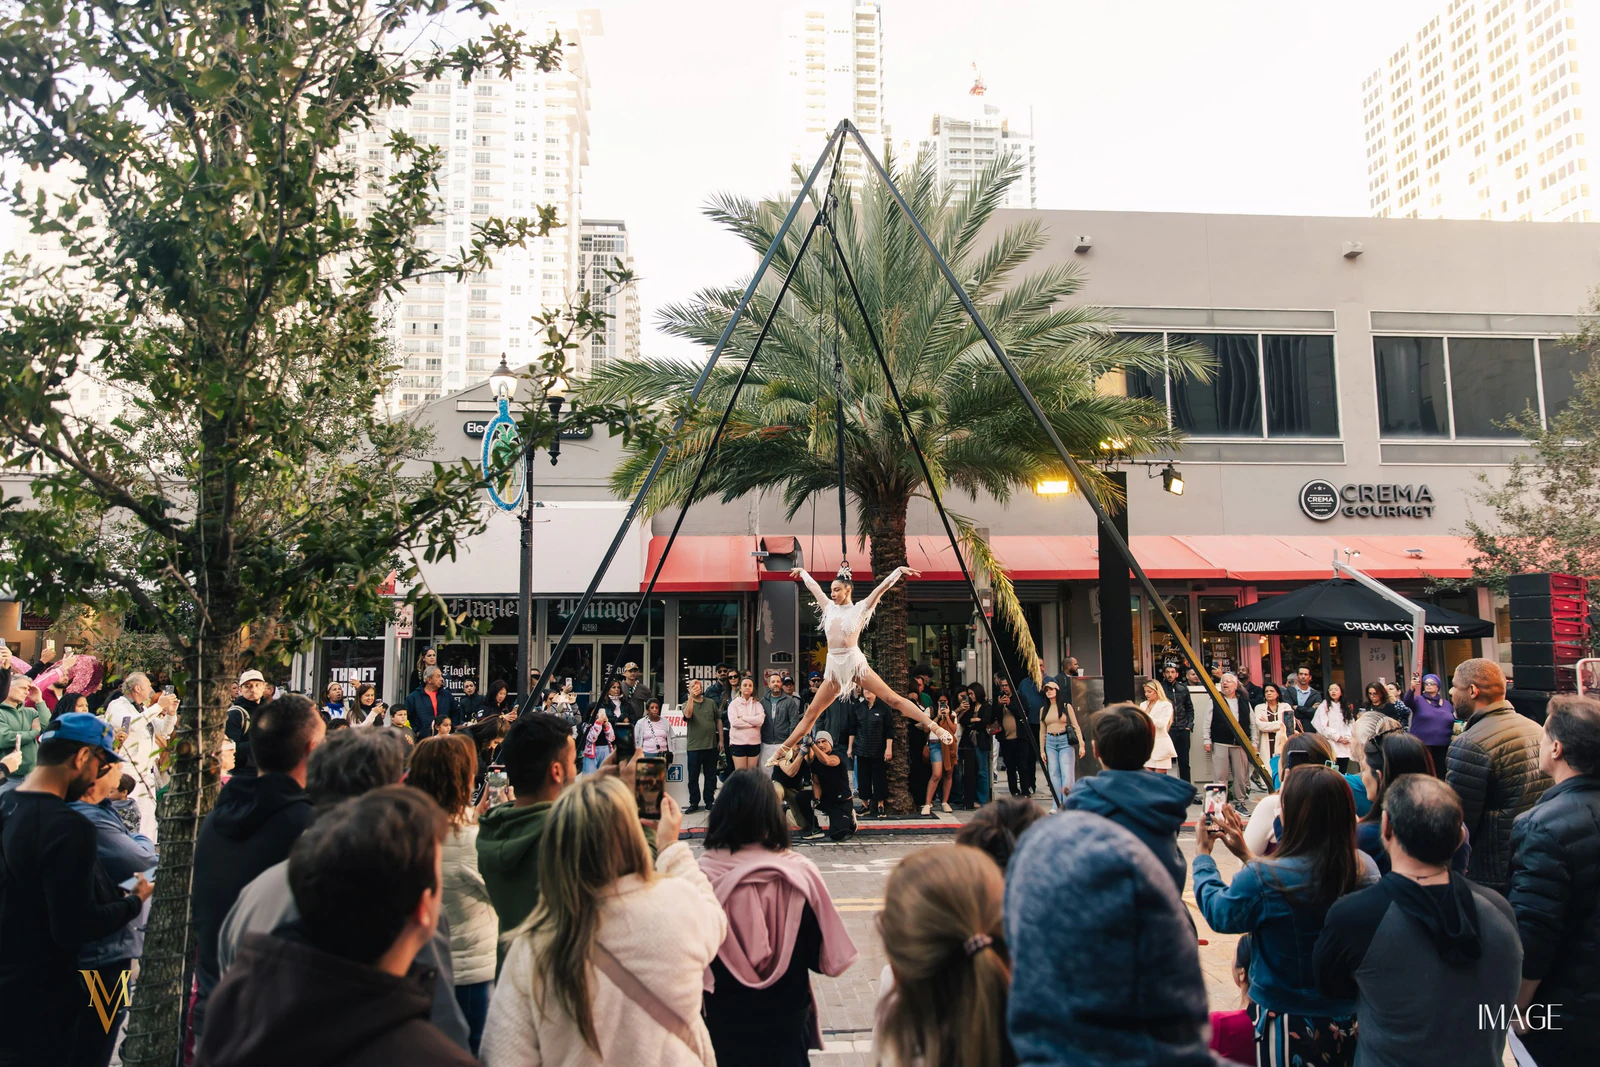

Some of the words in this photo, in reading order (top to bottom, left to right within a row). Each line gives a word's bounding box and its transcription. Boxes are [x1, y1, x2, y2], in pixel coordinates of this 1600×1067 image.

[1341, 483, 1436, 504] CREMA
[1341, 504, 1437, 519] GOURMET
[557, 599, 639, 623] Vntage
[1218, 622, 1241, 632] CREMA
[1242, 620, 1280, 632] GOURMET
[1344, 621, 1394, 632] CREMA
[1394, 623, 1460, 634] GORMET
[442, 664, 476, 677] Flagler
[687, 665, 718, 679] THRI
